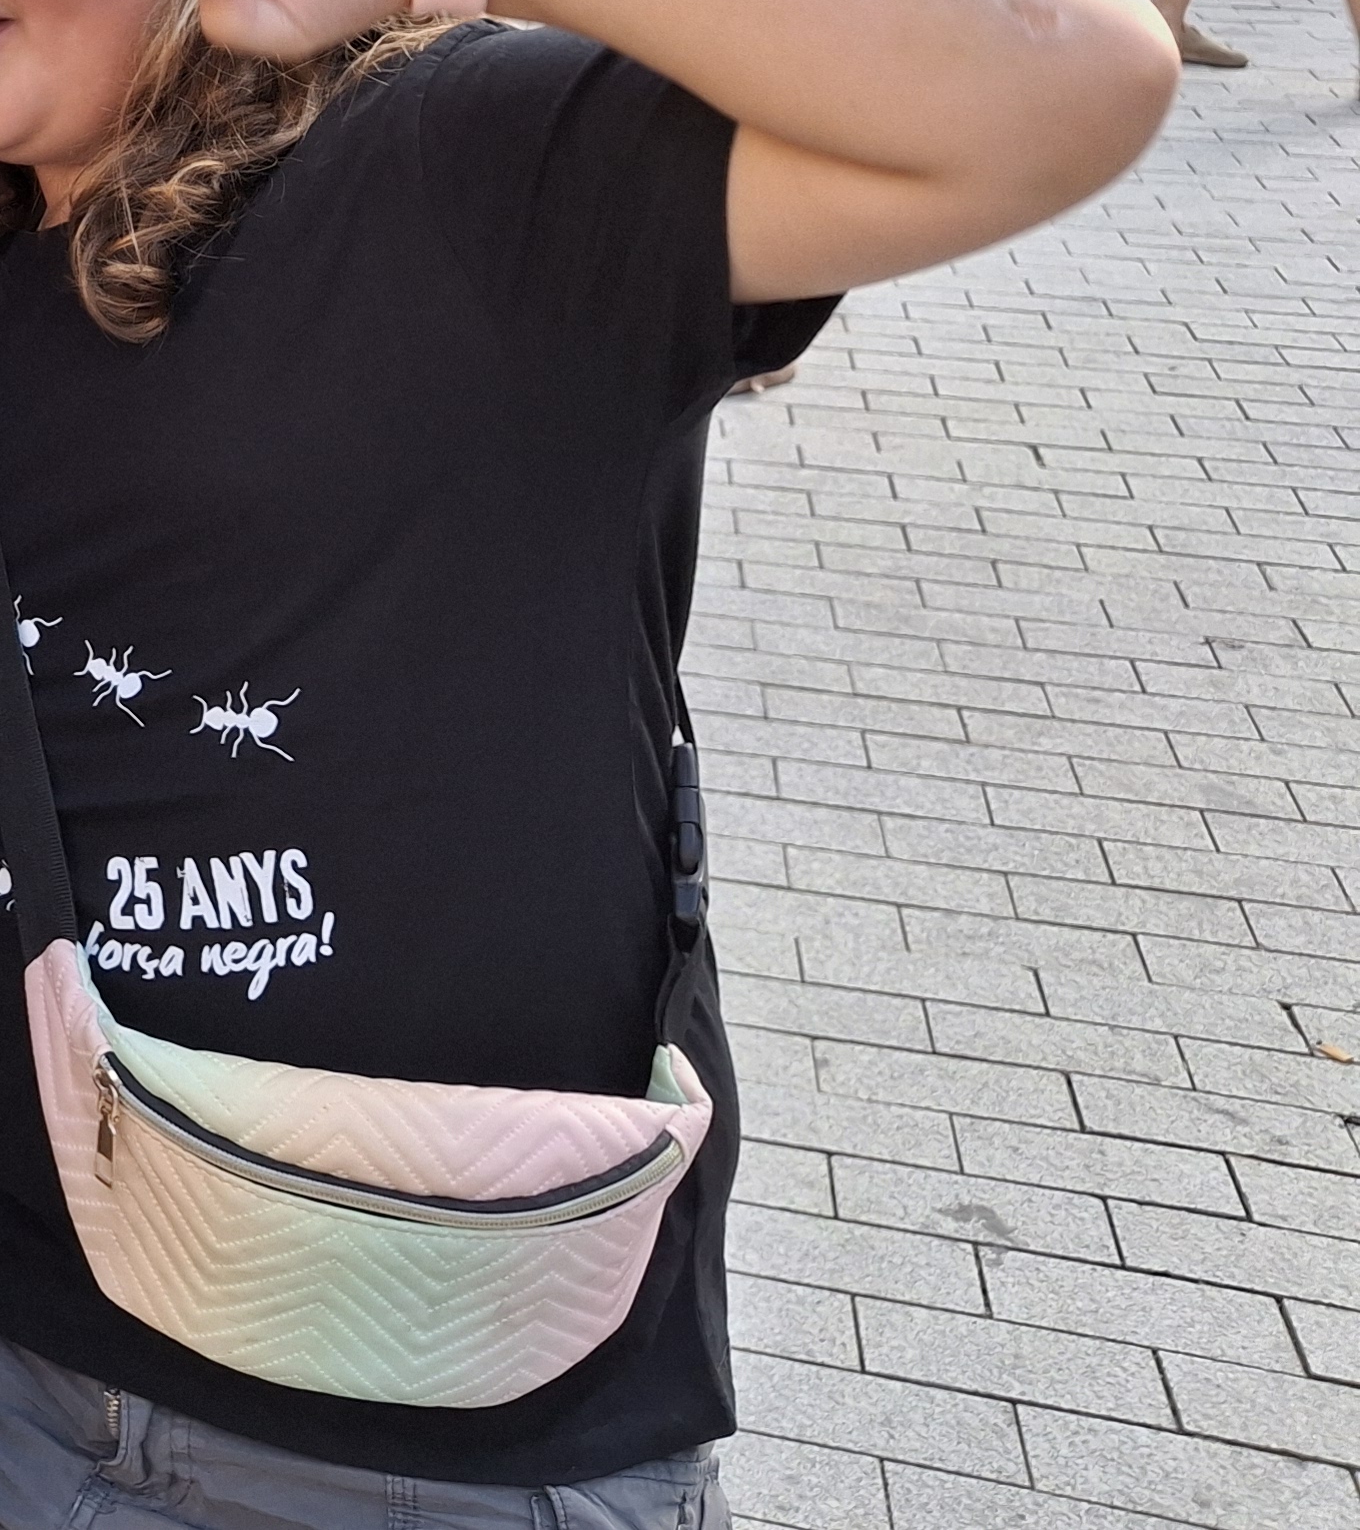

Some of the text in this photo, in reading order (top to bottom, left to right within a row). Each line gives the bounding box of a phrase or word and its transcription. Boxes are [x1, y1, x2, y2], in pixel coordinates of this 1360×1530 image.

[106, 847, 314, 931] 25 ANYS
[200, 910, 336, 1002] negra!
